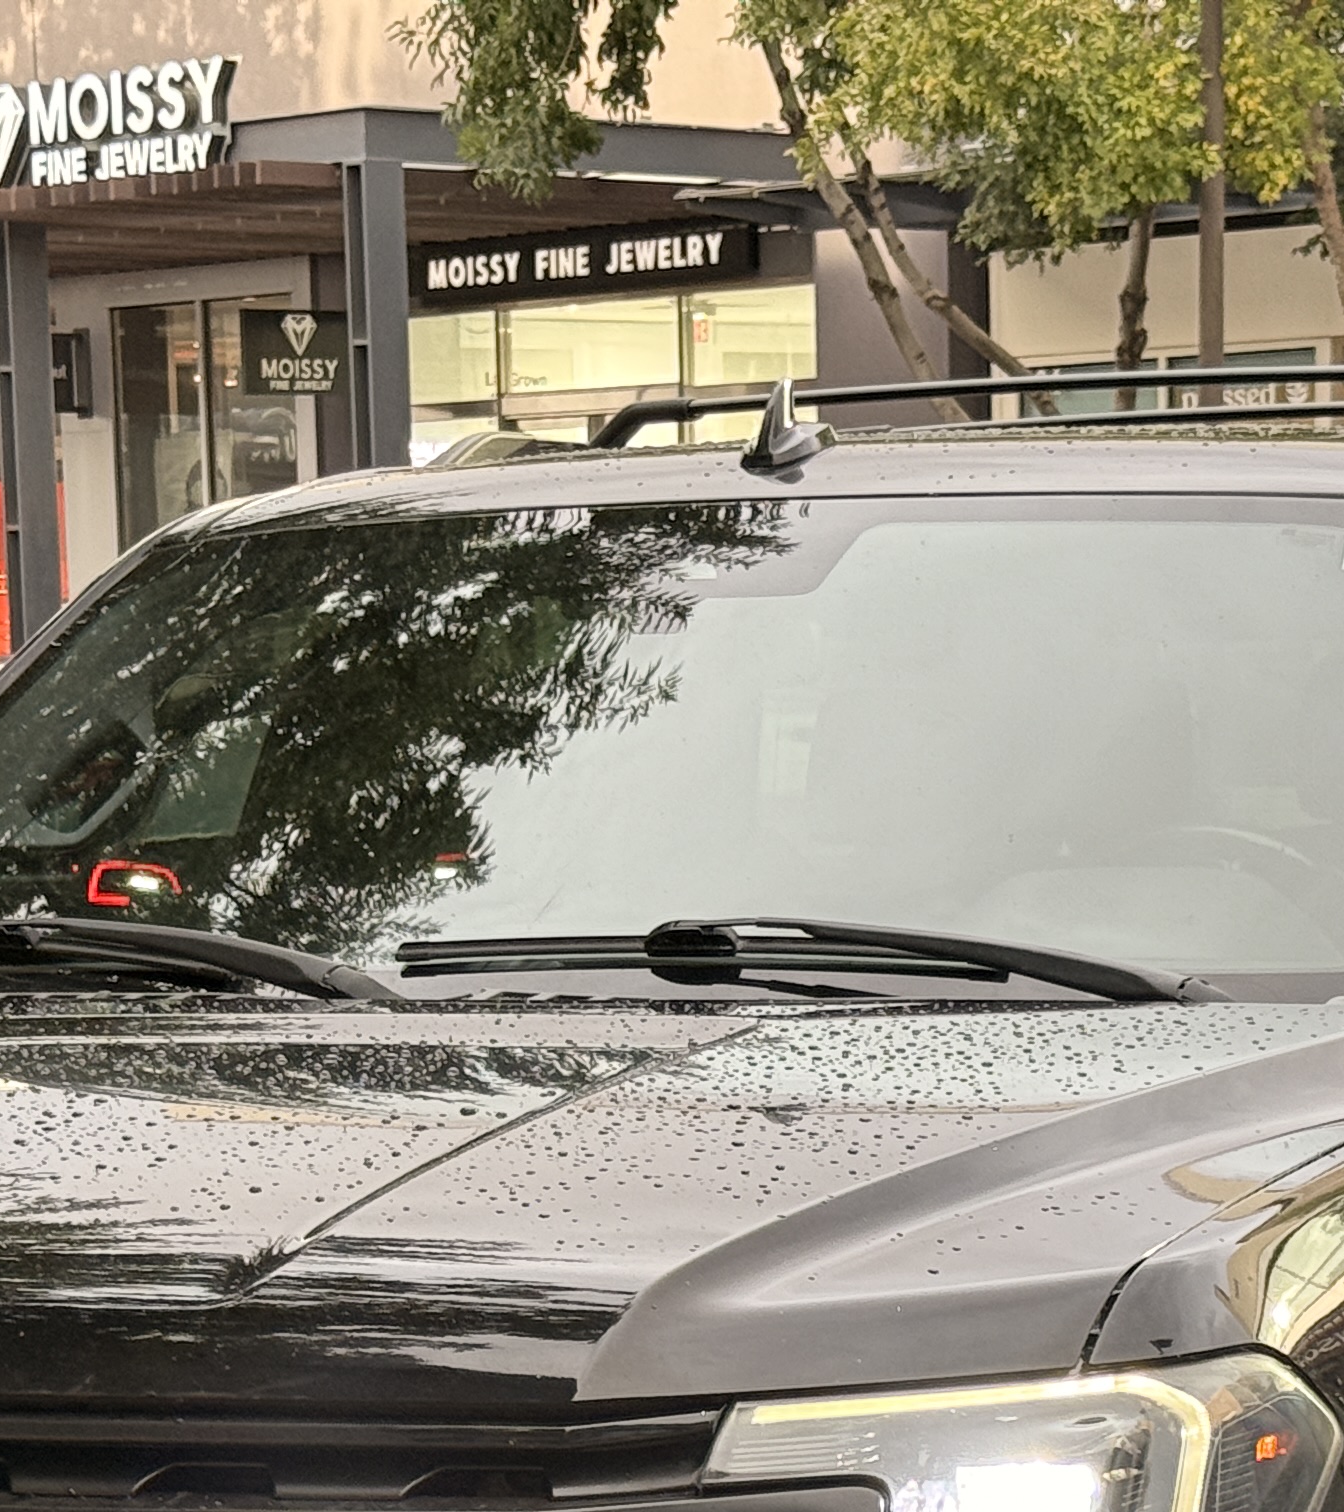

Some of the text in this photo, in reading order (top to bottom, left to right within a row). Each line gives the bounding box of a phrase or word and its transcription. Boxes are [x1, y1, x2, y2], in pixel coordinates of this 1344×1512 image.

[27, 54, 223, 145] MOISSY
[30, 131, 212, 188] FINE JEWELRY
[427, 232, 723, 290] MOISSY FINE JEWELRY
[260, 358, 338, 379] MOISSY
[1181, 382, 1276, 409] pssed
